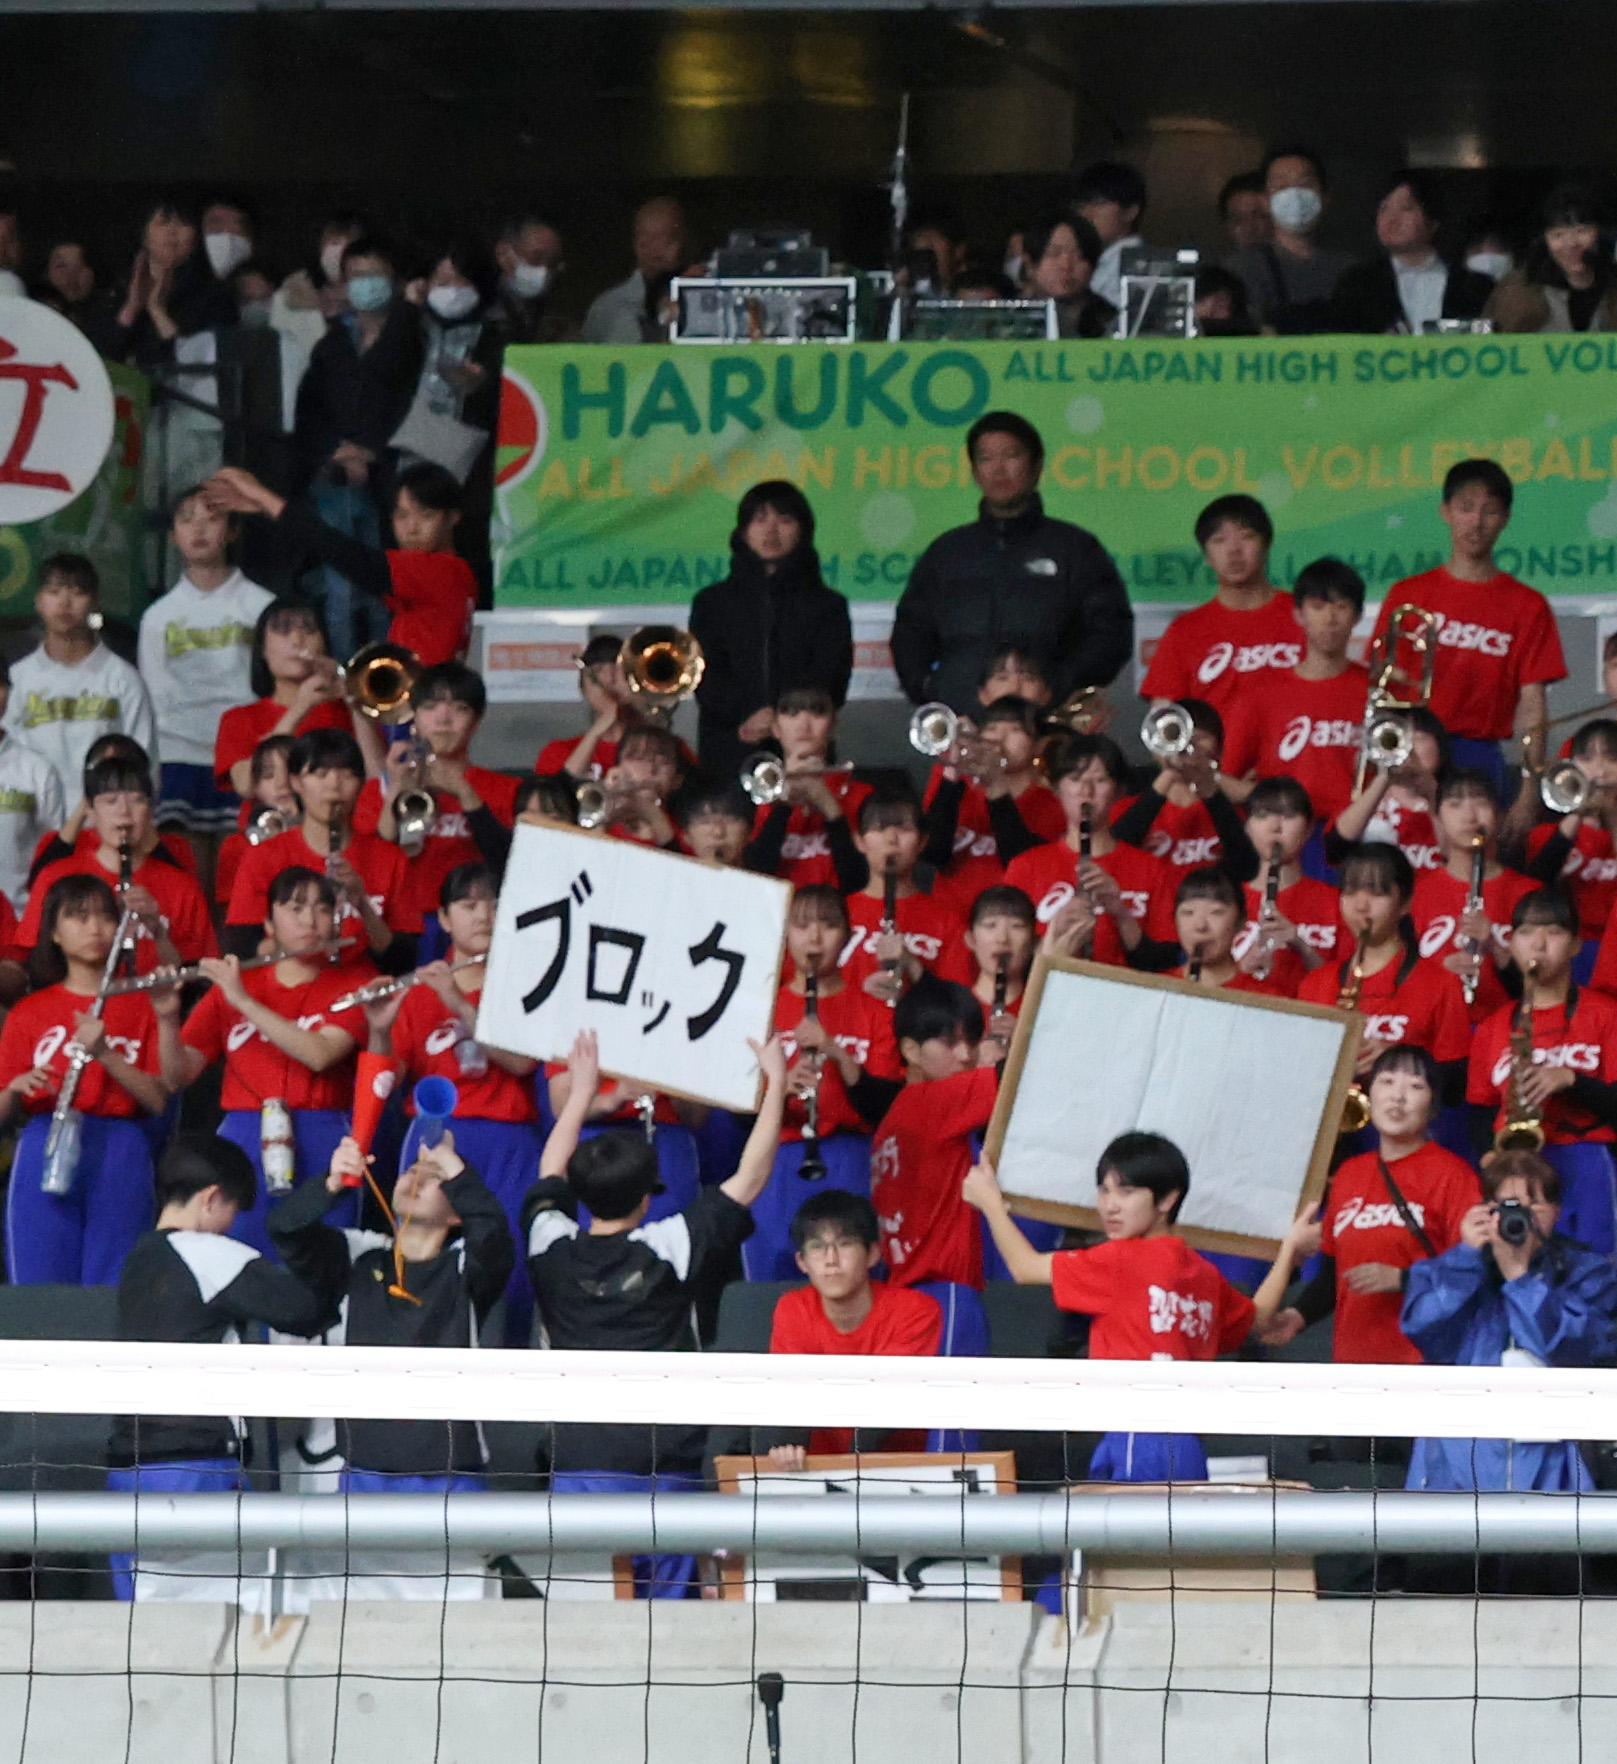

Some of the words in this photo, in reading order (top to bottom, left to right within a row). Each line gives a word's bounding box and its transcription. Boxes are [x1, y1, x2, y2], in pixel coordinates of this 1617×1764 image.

[561, 349, 991, 440] HARUKO
[1004, 350, 1075, 382] ALL
[1088, 350, 1223, 383] JAPAN
[1236, 349, 1338, 383] HIGH
[1354, 344, 1528, 382] SCHOOL
[537, 456, 633, 500] ALL
[650, 444, 836, 496] JAPAN
[1050, 444, 1262, 492] CHOOL
[500, 556, 574, 590] ALL
[516, 869, 746, 1042] ブロック
